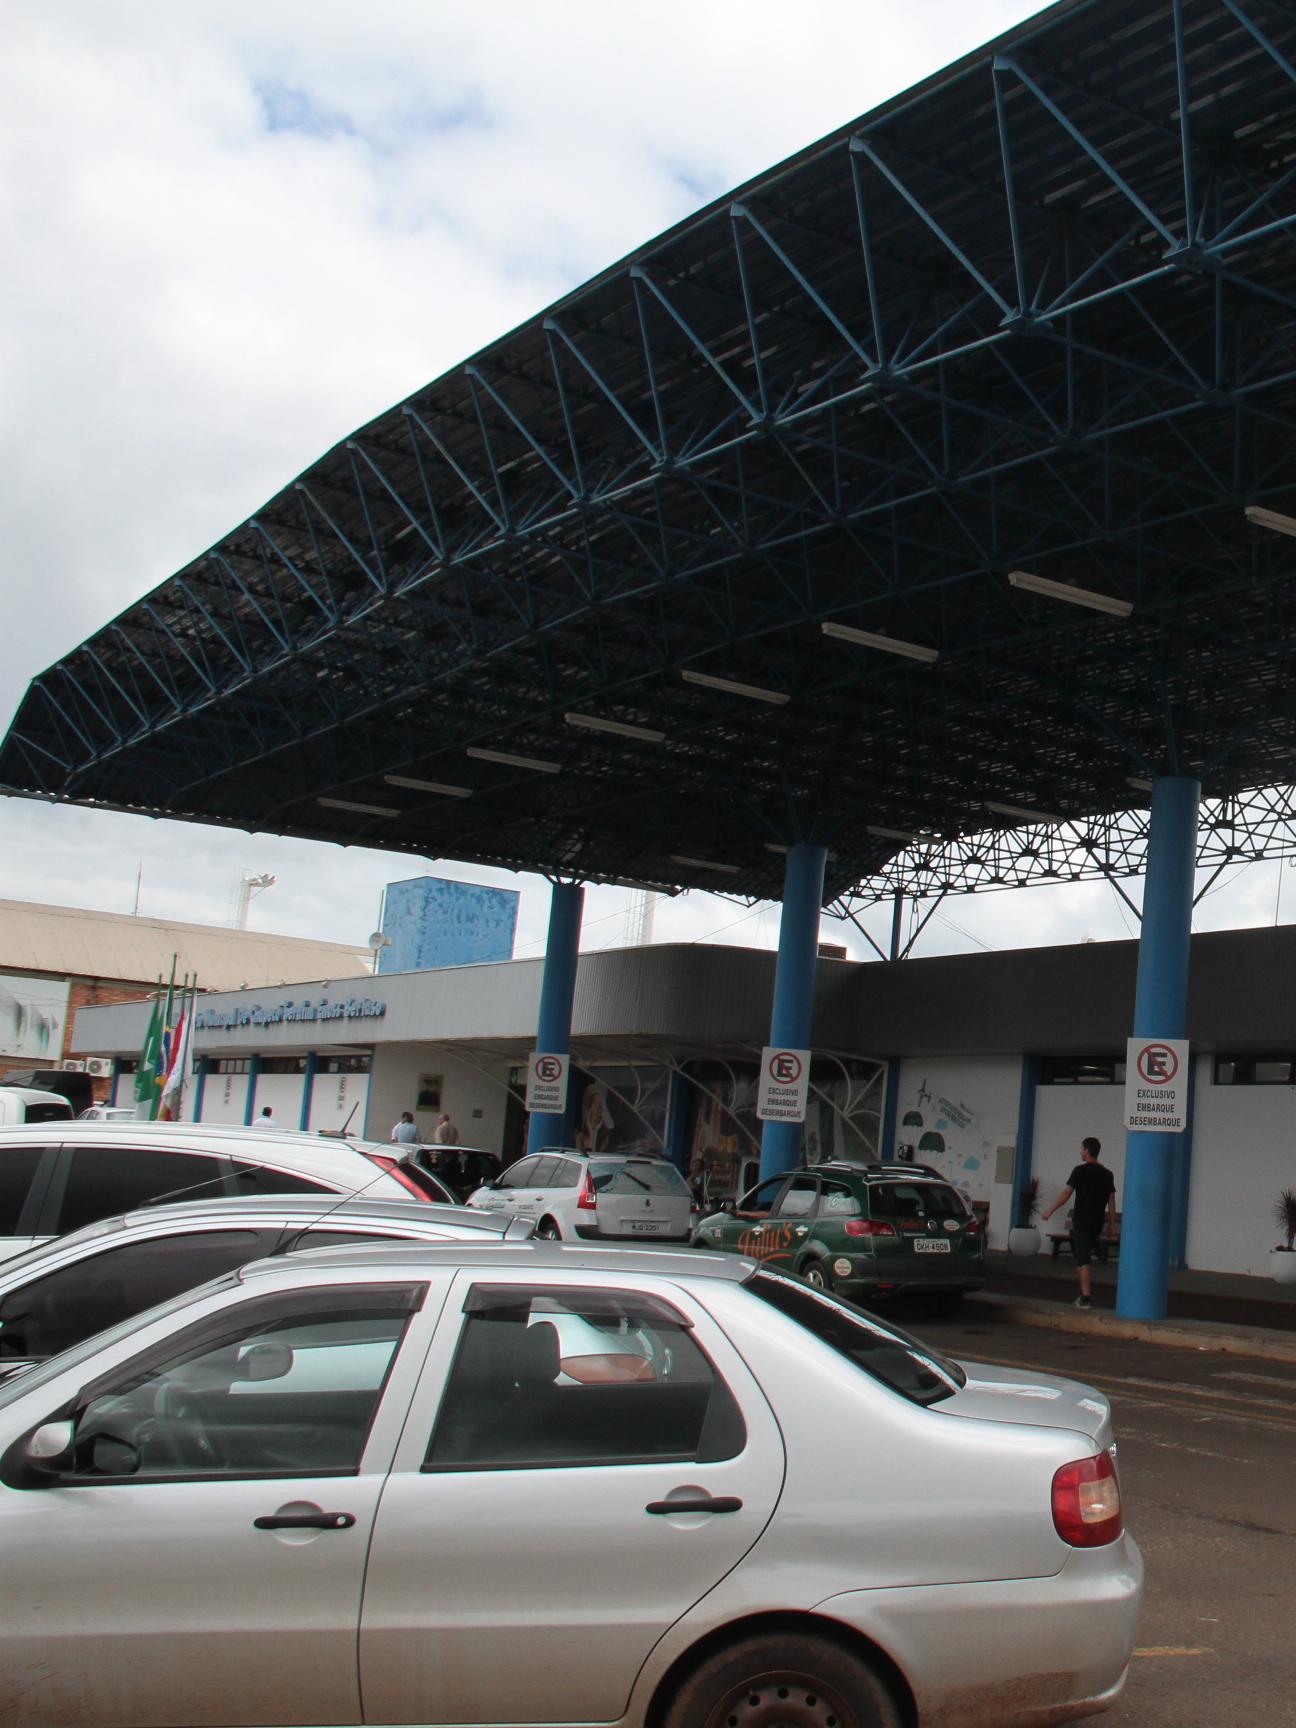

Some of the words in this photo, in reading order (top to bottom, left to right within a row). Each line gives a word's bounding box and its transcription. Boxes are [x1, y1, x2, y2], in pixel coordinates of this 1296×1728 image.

[1147, 1052, 1168, 1076] E
[534, 1084, 560, 1092] EXCLUSIVO
[768, 1086, 798, 1096] EXCLUSIVO
[534, 1093, 560, 1102] EMBARQUE
[1137, 1088, 1176, 1099] EXCLUSIVO
[529, 1102, 563, 1110] DESEMBARQUE
[767, 1097, 798, 1107] EMBARQUE
[761, 1107, 802, 1118] DESEMBARQUE
[1136, 1102, 1175, 1113] EMBARQUE
[1129, 1115, 1181, 1127] DESEMBARQUE
